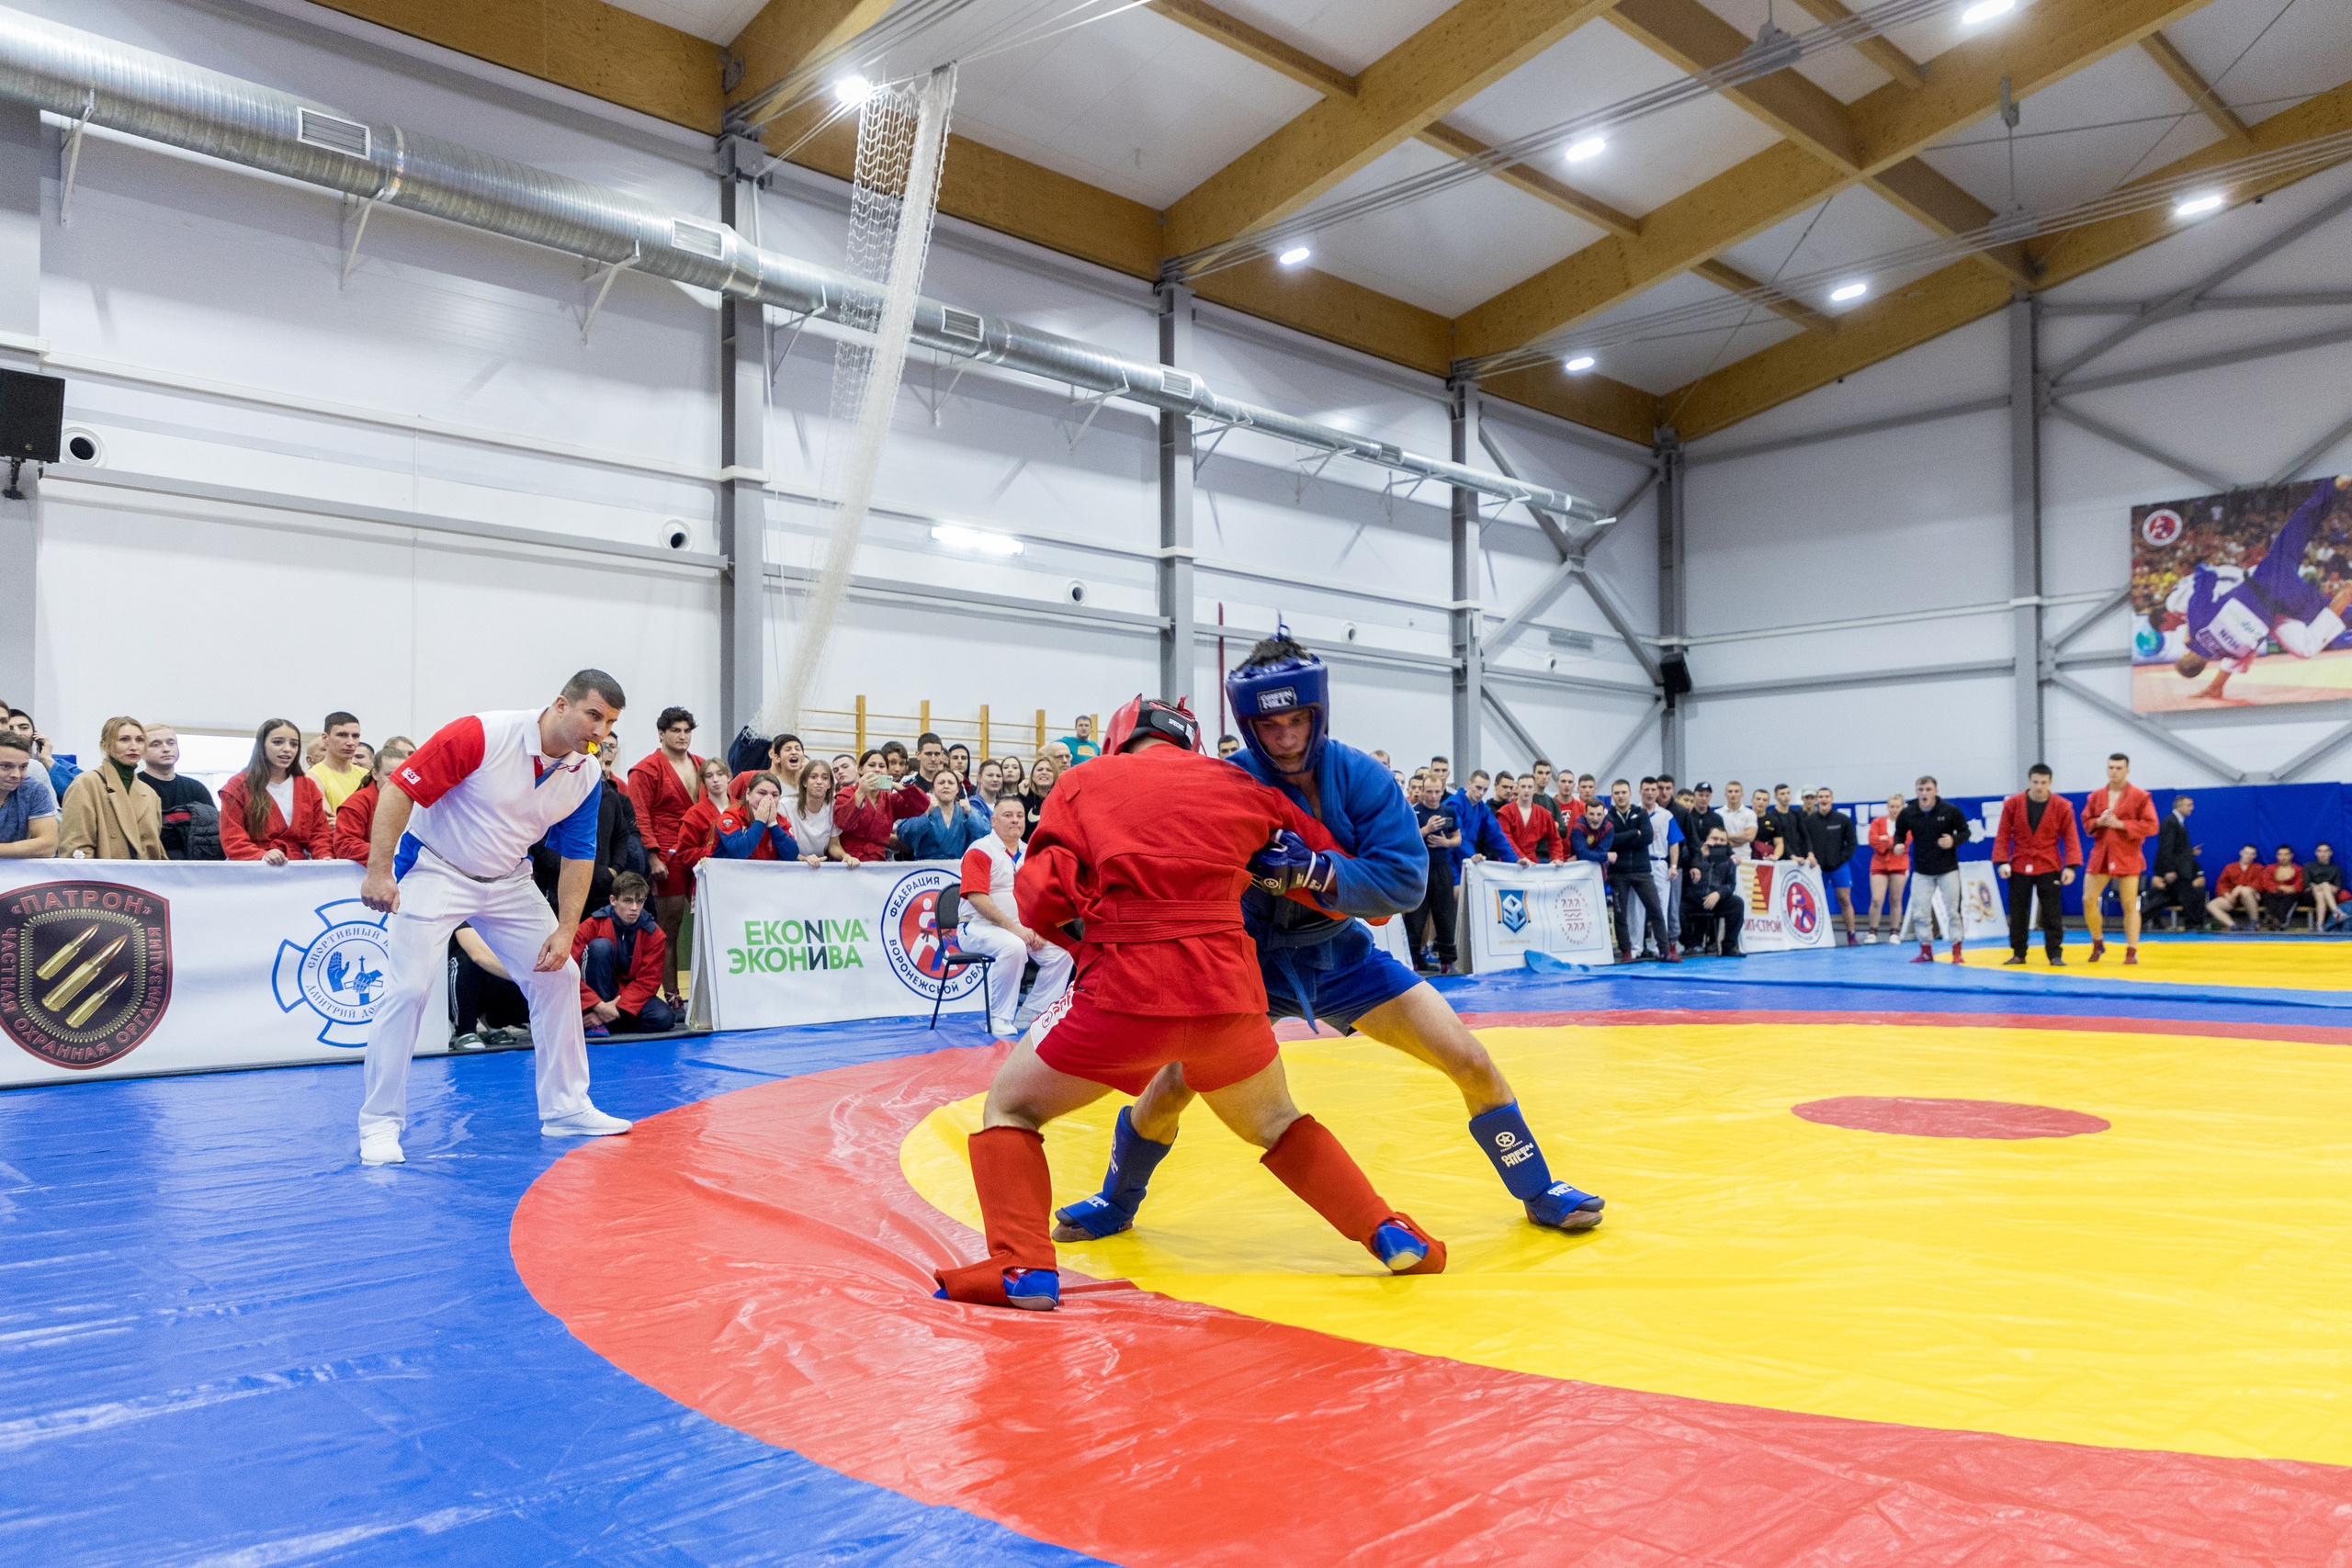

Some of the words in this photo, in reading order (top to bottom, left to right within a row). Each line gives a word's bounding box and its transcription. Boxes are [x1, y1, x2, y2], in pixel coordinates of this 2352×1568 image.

[11, 890, 153, 915] «ПАТРОН»
[890, 876, 940, 918] ФЕДЕРАЦИЯ
[307, 927, 381, 969] СПОРТИВНЫЙ
[744, 919, 870, 945] EKONIVA
[727, 944, 865, 975] ЭКОНИВА
[1, 927, 19, 1013] ЧАСТНАЯ
[14, 1018, 111, 1061] ОХРАННАЯ
[116, 927, 164, 1044] ОРГАНИЗАЦИЯ
[306, 984, 356, 1019] ДМИТРИЙ
[361, 1003, 378, 1019] ДО
